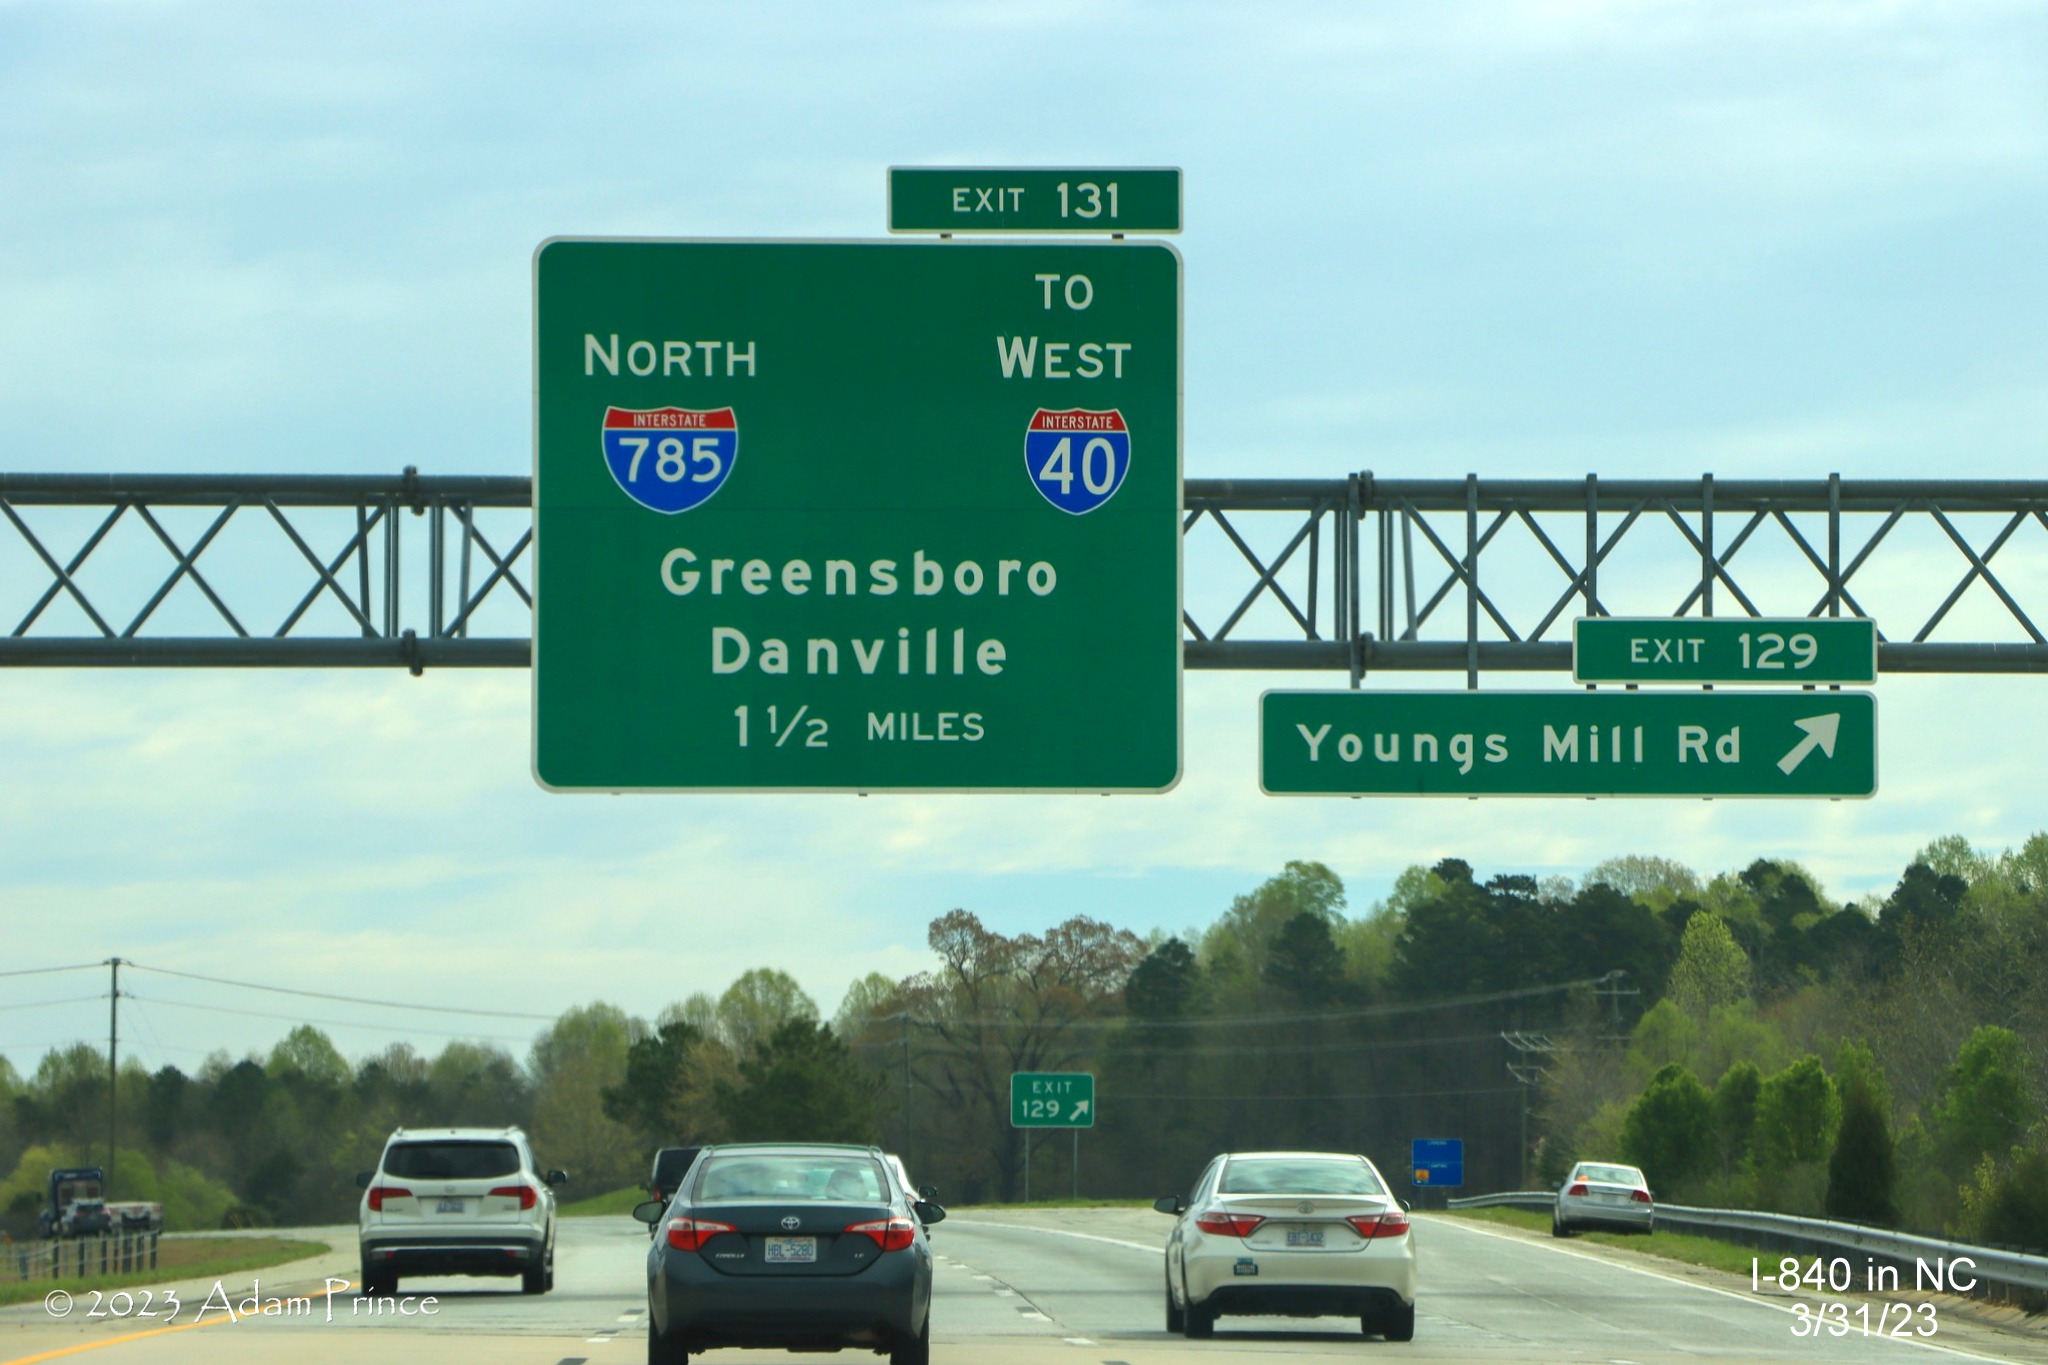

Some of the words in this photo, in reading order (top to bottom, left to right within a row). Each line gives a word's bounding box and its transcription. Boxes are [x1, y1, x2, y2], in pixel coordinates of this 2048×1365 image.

[953, 188, 1024, 211] EXIT
[1058, 183, 1117, 217] 131
[1035, 274, 1093, 309] TO
[585, 334, 755, 376] NORTH
[997, 337, 1131, 378] WEST
[633, 413, 706, 427] INTERSTATE
[1042, 415, 1113, 429] INTERSTATE
[618, 437, 722, 483] 785
[1039, 437, 1116, 496] 40
[661, 548, 1056, 595] Greensboro
[713, 627, 1006, 675] Danville
[1632, 639, 1704, 662] EXIT
[1739, 634, 1817, 668] 129
[735, 706, 747, 746] 1
[868, 712, 984, 740] MILES
[1297, 724, 1508, 774] Youngs
[1544, 725, 1642, 762] Mill
[1679, 726, 1739, 762] Rd
[1033, 1081, 1071, 1093] EXIT
[1023, 1100, 1059, 1117] 129
